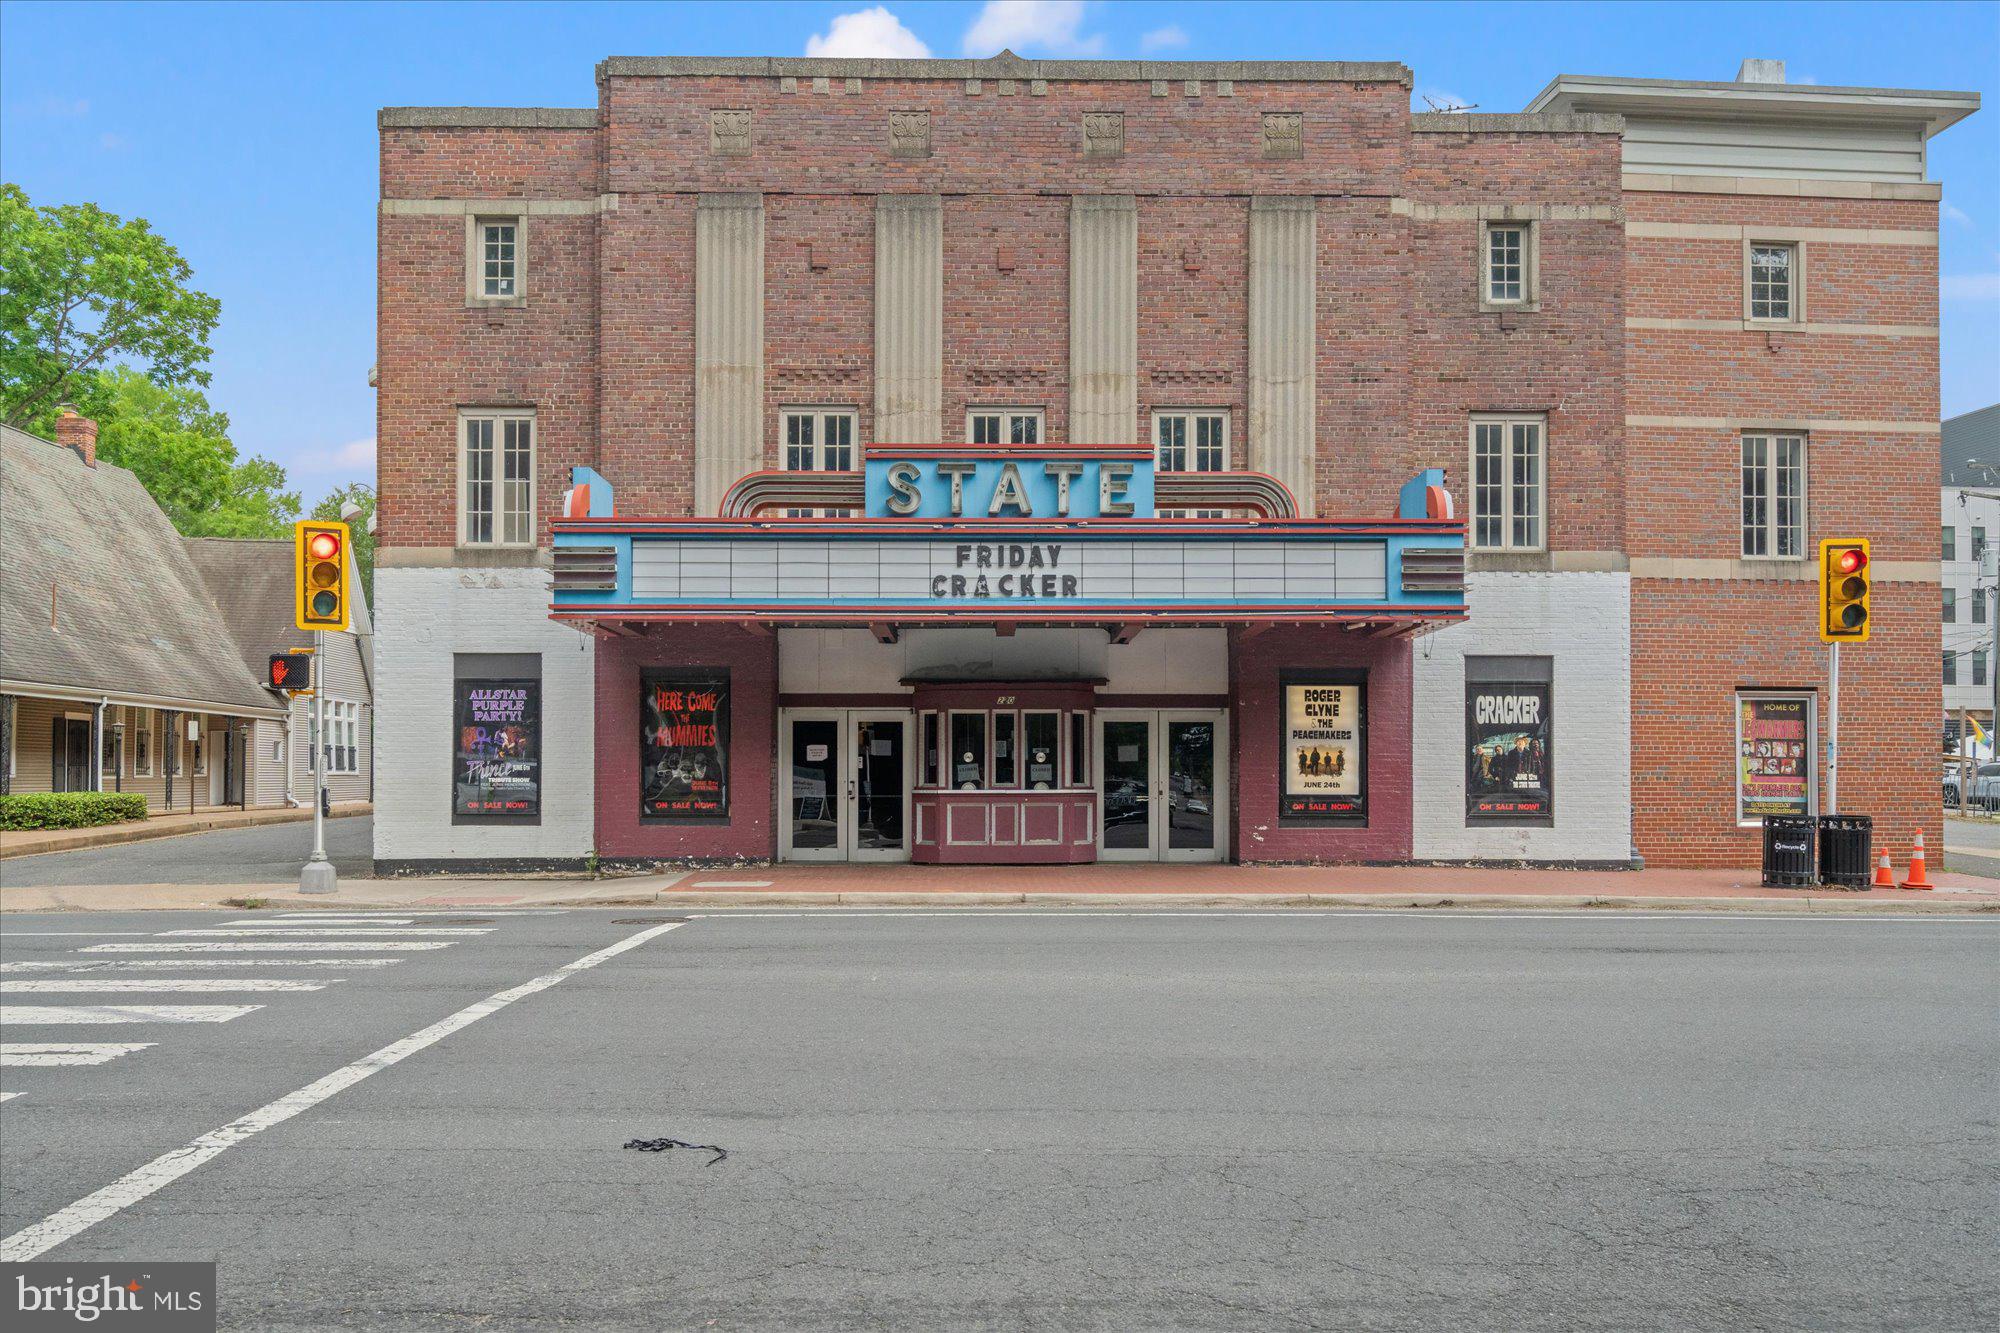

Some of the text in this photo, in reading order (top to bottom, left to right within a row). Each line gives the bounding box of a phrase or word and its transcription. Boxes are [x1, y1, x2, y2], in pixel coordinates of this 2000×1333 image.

[885, 461, 1136, 515] STATE
[956, 544, 1062, 569] FRIDAY
[931, 574, 1079, 598] CRACKER
[469, 689, 528, 700] ALLSTAR
[656, 686, 717, 712] HERE COME
[1304, 689, 1341, 702] ROGER
[472, 700, 525, 711] PURPLE
[1305, 703, 1340, 717] CLYNE
[1475, 695, 1540, 724] CRACKER
[474, 711, 523, 721] PARTY!
[681, 713, 690, 723] THE
[1317, 719, 1333, 728] THE
[656, 724, 716, 747] MUMMIES
[1292, 730, 1352, 740] PEACEMAKERS
[1303, 781, 1341, 789] JUNE 24th
[467, 801, 528, 809] ON SALE NOW!
[655, 801, 717, 809] ON SALE NOW!
[1292, 803, 1353, 811] ON SALE NOW!
[1479, 803, 1540, 811] ON SALE NOW!
